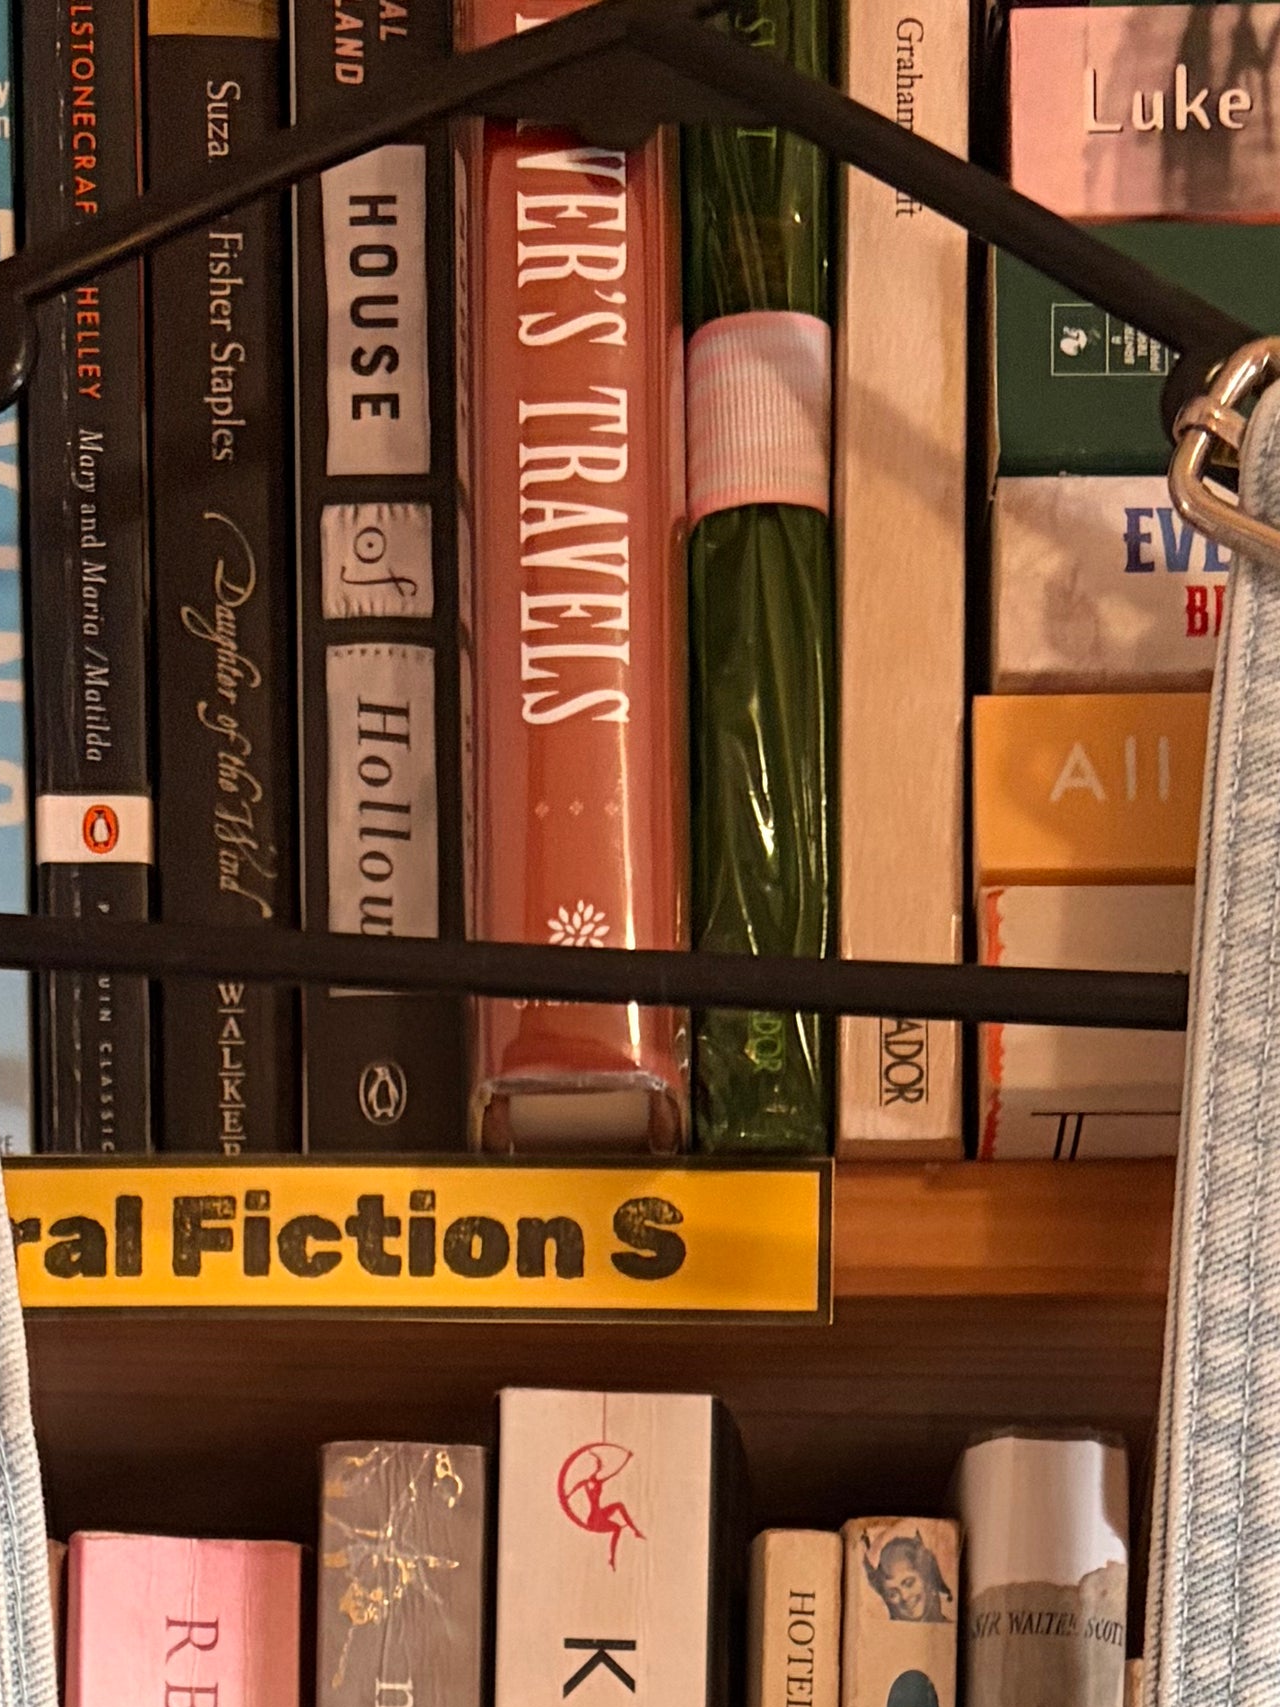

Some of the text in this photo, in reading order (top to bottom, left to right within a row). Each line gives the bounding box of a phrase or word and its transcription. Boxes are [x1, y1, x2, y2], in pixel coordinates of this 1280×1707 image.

[1083, 64, 1255, 135] Luke
[204, 230, 247, 463] Fisher Staples
[349, 194, 400, 421] HOUSE
[70, 429, 110, 637] Mary and Maria
[181, 512, 260, 702] Daughter
[342, 526, 417, 598] of
[520, 385, 630, 725] TRAVELS
[1049, 735, 1170, 802] All
[173, 1189, 590, 1281] Fiction
[610, 1192, 687, 1281] S
